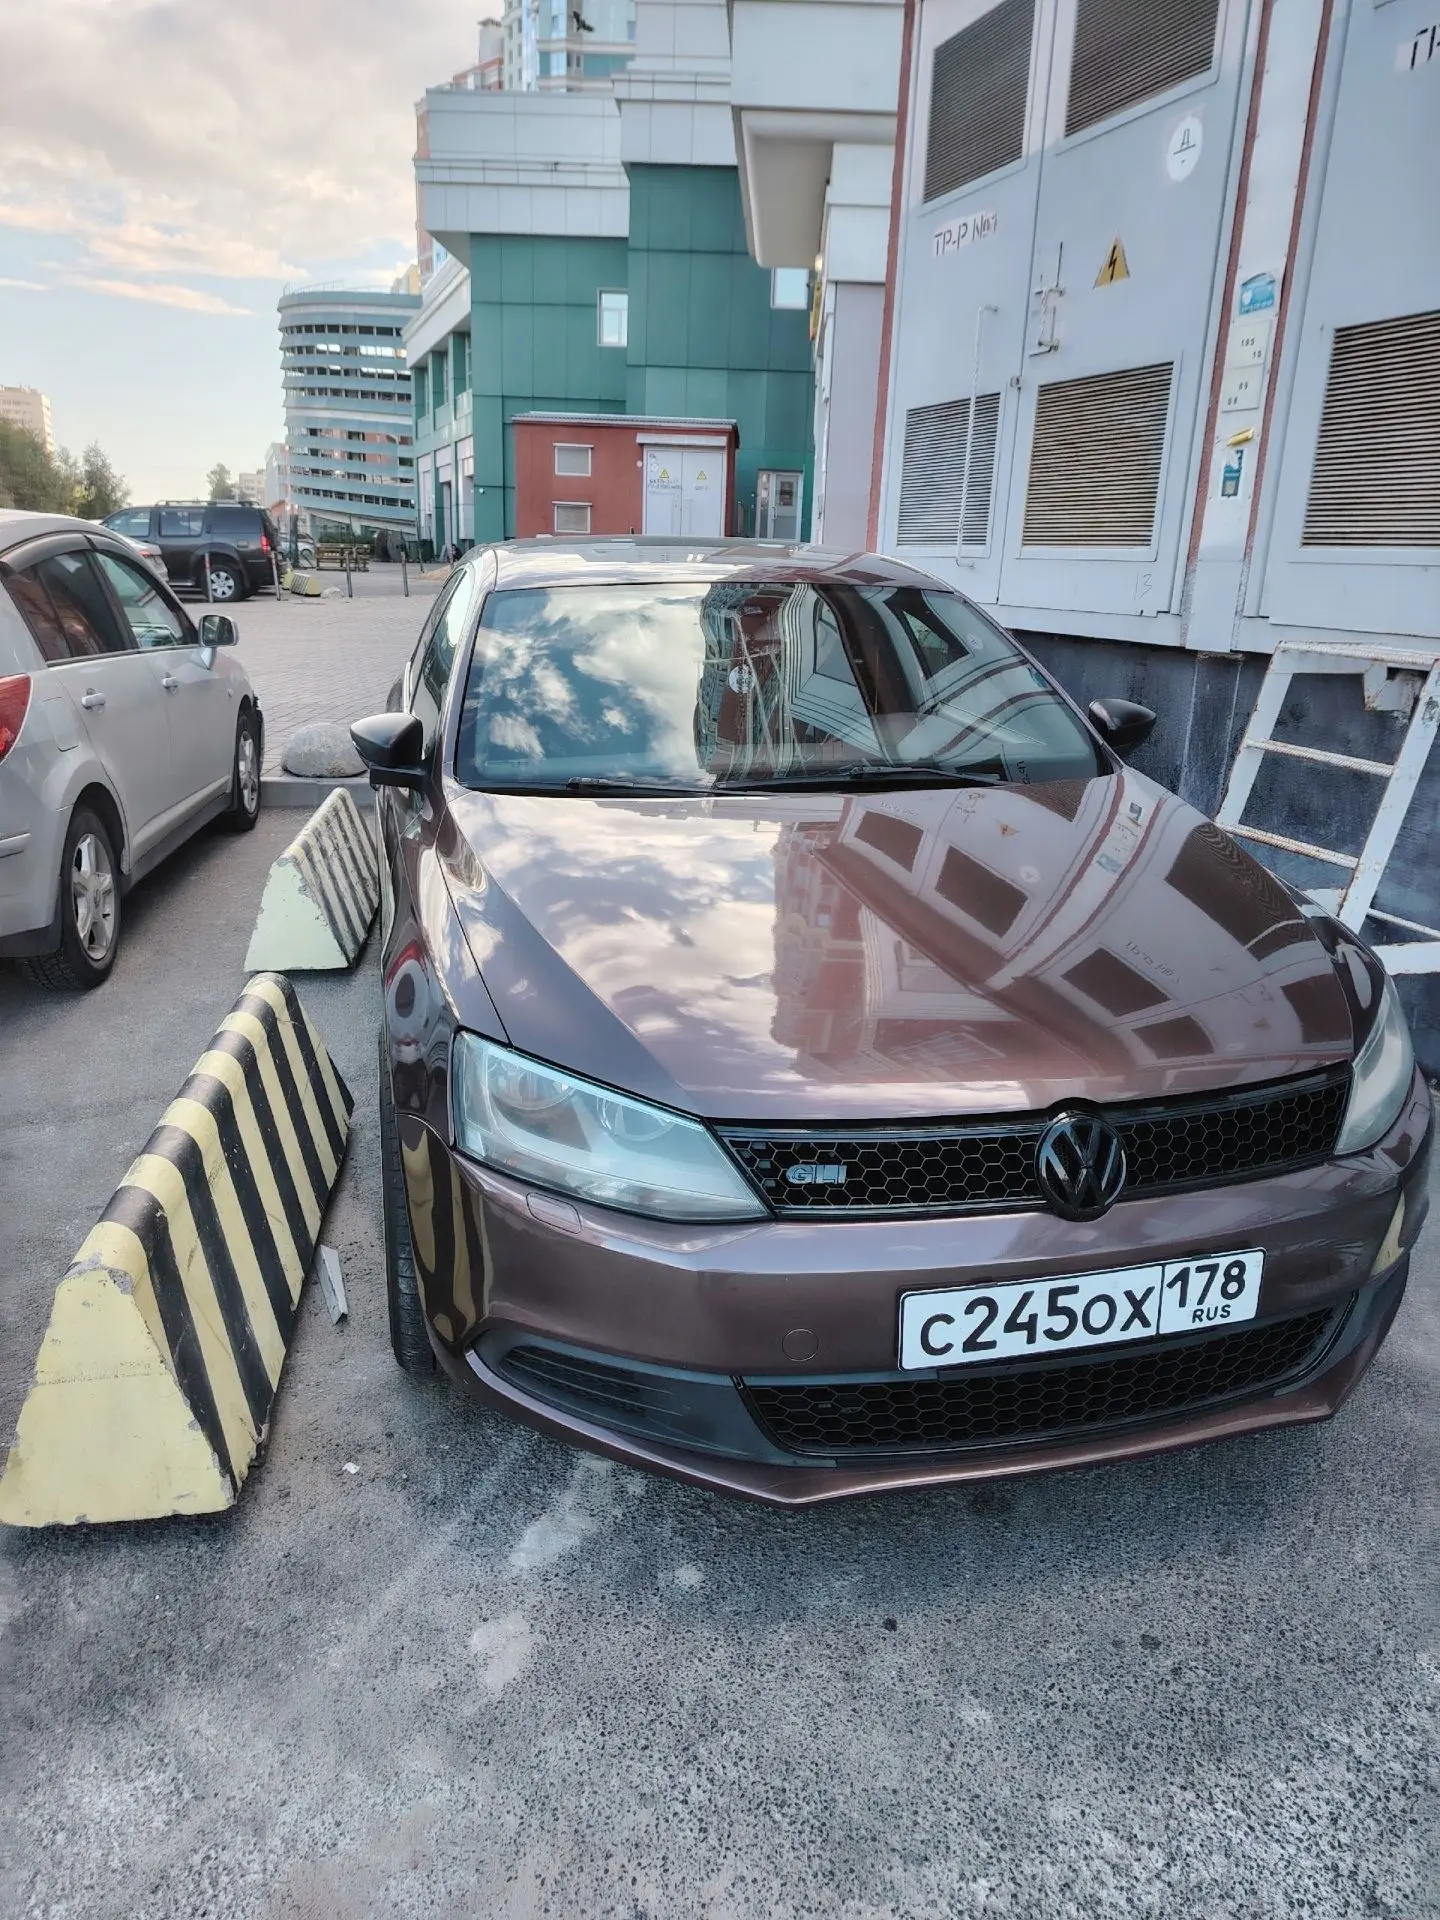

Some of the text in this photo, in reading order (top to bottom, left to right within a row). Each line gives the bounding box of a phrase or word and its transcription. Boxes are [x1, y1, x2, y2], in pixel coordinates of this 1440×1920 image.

[786, 1163, 847, 1185] GLI
[1166, 1259, 1247, 1309] 178
[1191, 1303, 1232, 1324] RUS
